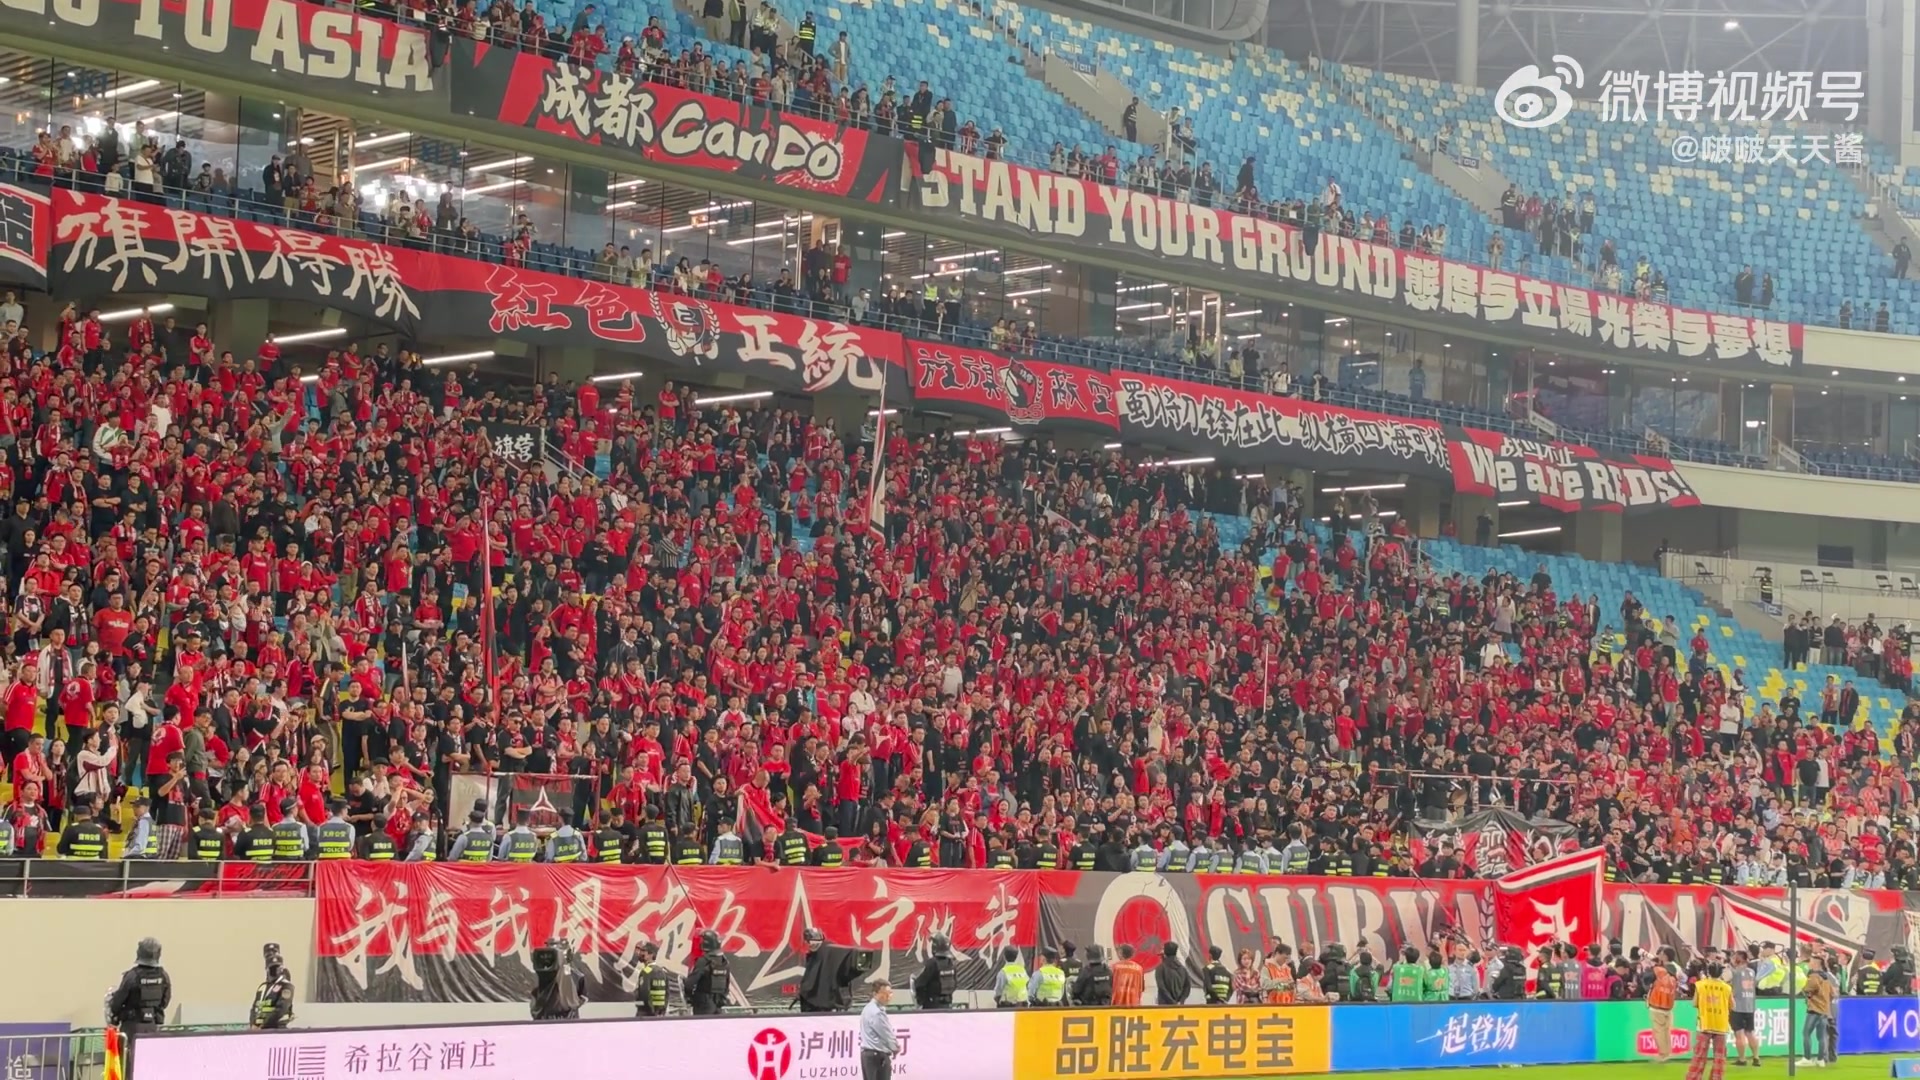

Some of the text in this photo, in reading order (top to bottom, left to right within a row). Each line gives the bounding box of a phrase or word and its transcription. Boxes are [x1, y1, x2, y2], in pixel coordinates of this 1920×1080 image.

[250, 0, 433, 92] ASIA
[542, 61, 655, 147] 成都
[921, 147, 1397, 299] STAND YOUR GROUND
[485, 263, 884, 392] 紅色 正統
[1460, 441, 1693, 507] We are REDS!
[343, 1039, 498, 1074] 希拉谷酒庄
[798, 1028, 912, 1061] 泸州行
[1055, 1012, 1294, 1075] 品胜充电宝
[1416, 1012, 1519, 1058] 一起登场
[800, 1066, 858, 1079] LUZHOU
